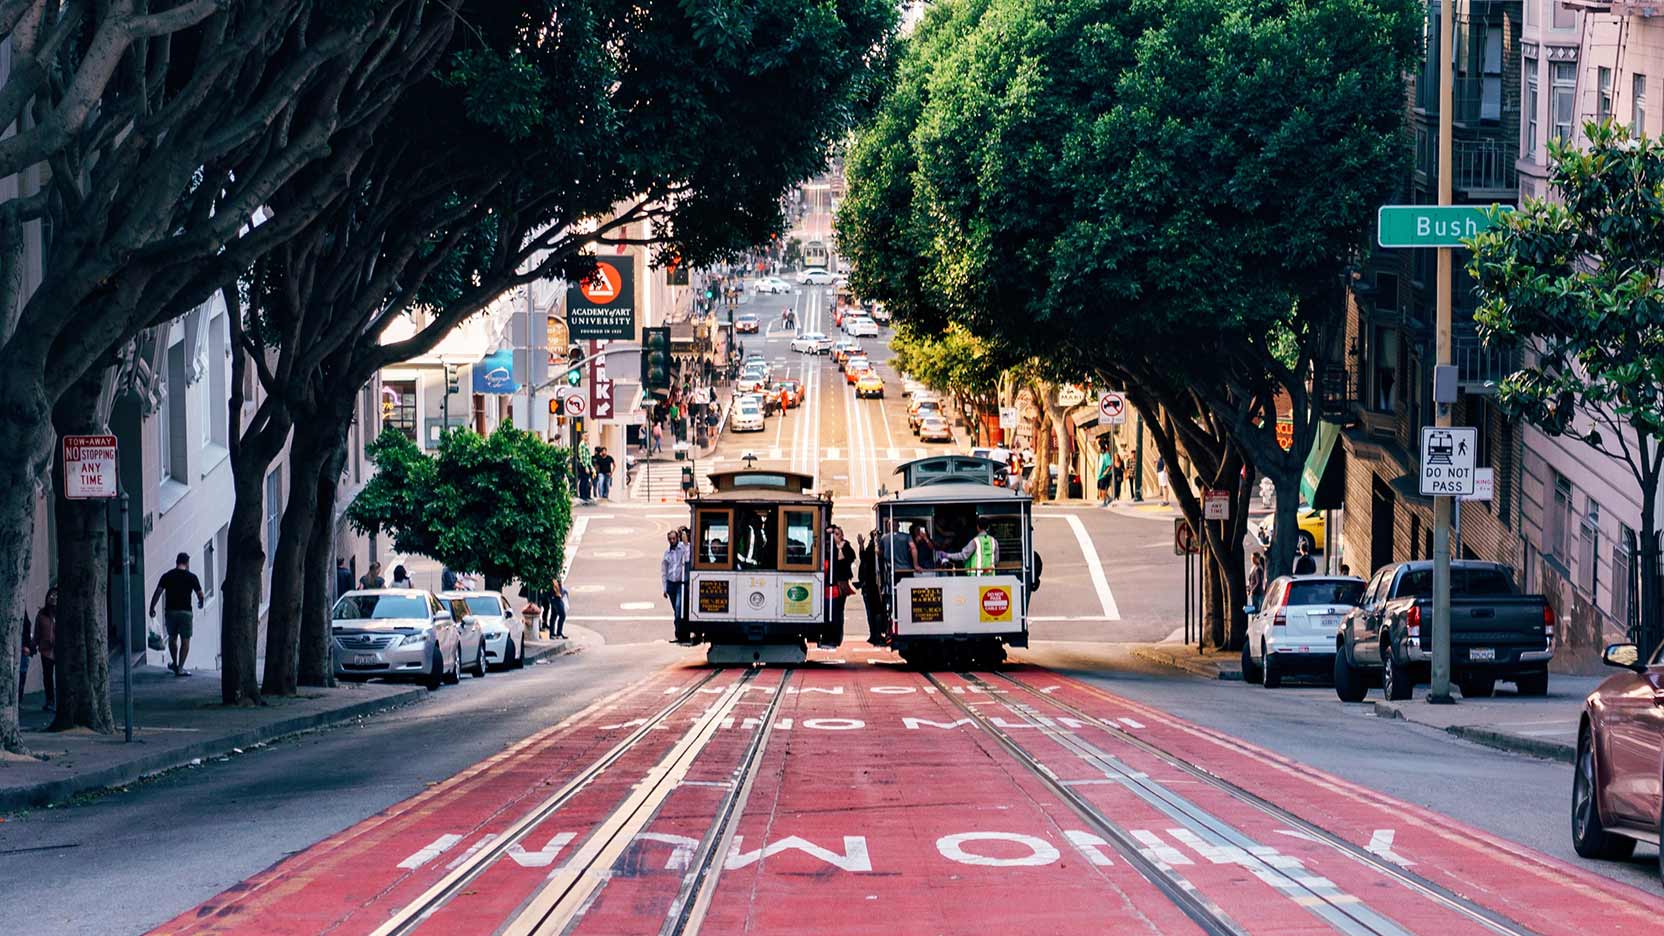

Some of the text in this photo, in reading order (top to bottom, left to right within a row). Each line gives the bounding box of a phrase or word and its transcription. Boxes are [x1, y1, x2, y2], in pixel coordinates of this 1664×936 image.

[1416, 216, 1477, 236] Bush
[571, 308, 609, 316] ACADEMY
[616, 308, 631, 316] ART
[571, 317, 631, 325] UNIVERSITY
[68, 438, 112, 446] TOW-AWAY
[66, 446, 114, 460] NO STOPPING
[81, 463, 101, 473] ANY
[1426, 467, 1469, 478] DO NOT
[81, 475, 103, 485] TIME
[1432, 481, 1462, 491] PASS
